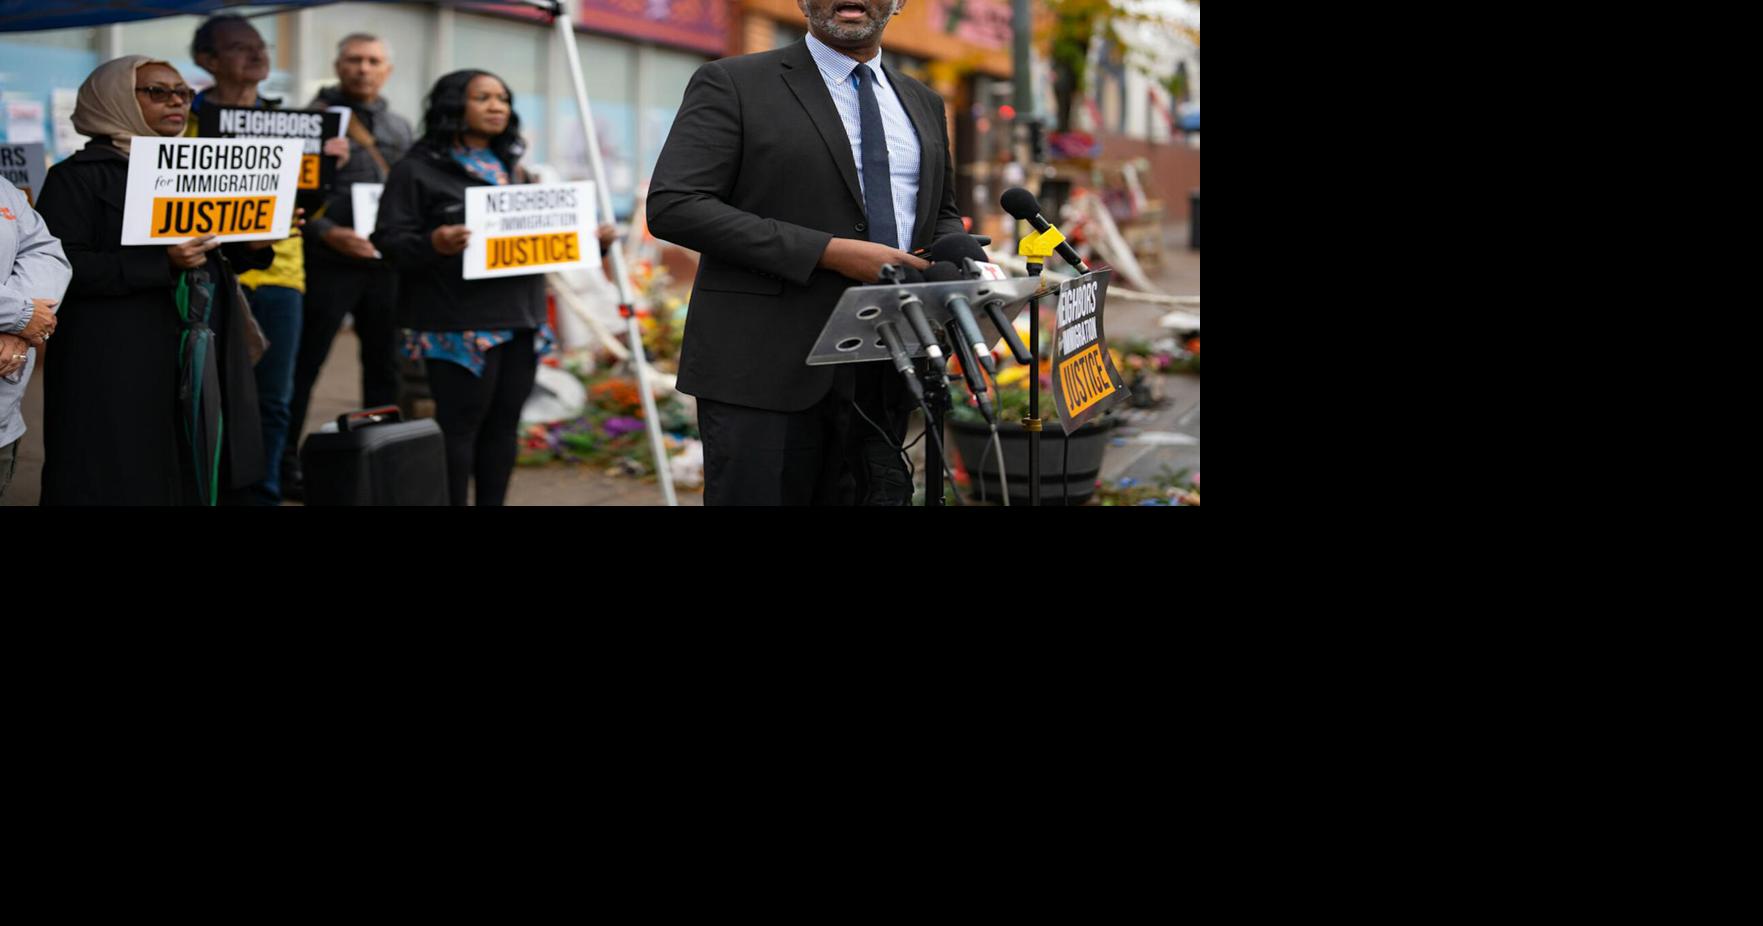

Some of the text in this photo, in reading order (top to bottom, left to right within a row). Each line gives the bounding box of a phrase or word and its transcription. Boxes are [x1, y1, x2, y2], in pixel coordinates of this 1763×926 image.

[220, 109, 322, 137] NEIGHBORS
[157, 144, 284, 170] NEIGHBORS
[154, 174, 280, 193] for IMMIGRATION
[486, 188, 578, 213] NEIGHBORS
[158, 199, 271, 234] JUSTICE
[491, 233, 576, 268] JUSTICE
[1063, 349, 1110, 411] JUSTICE
